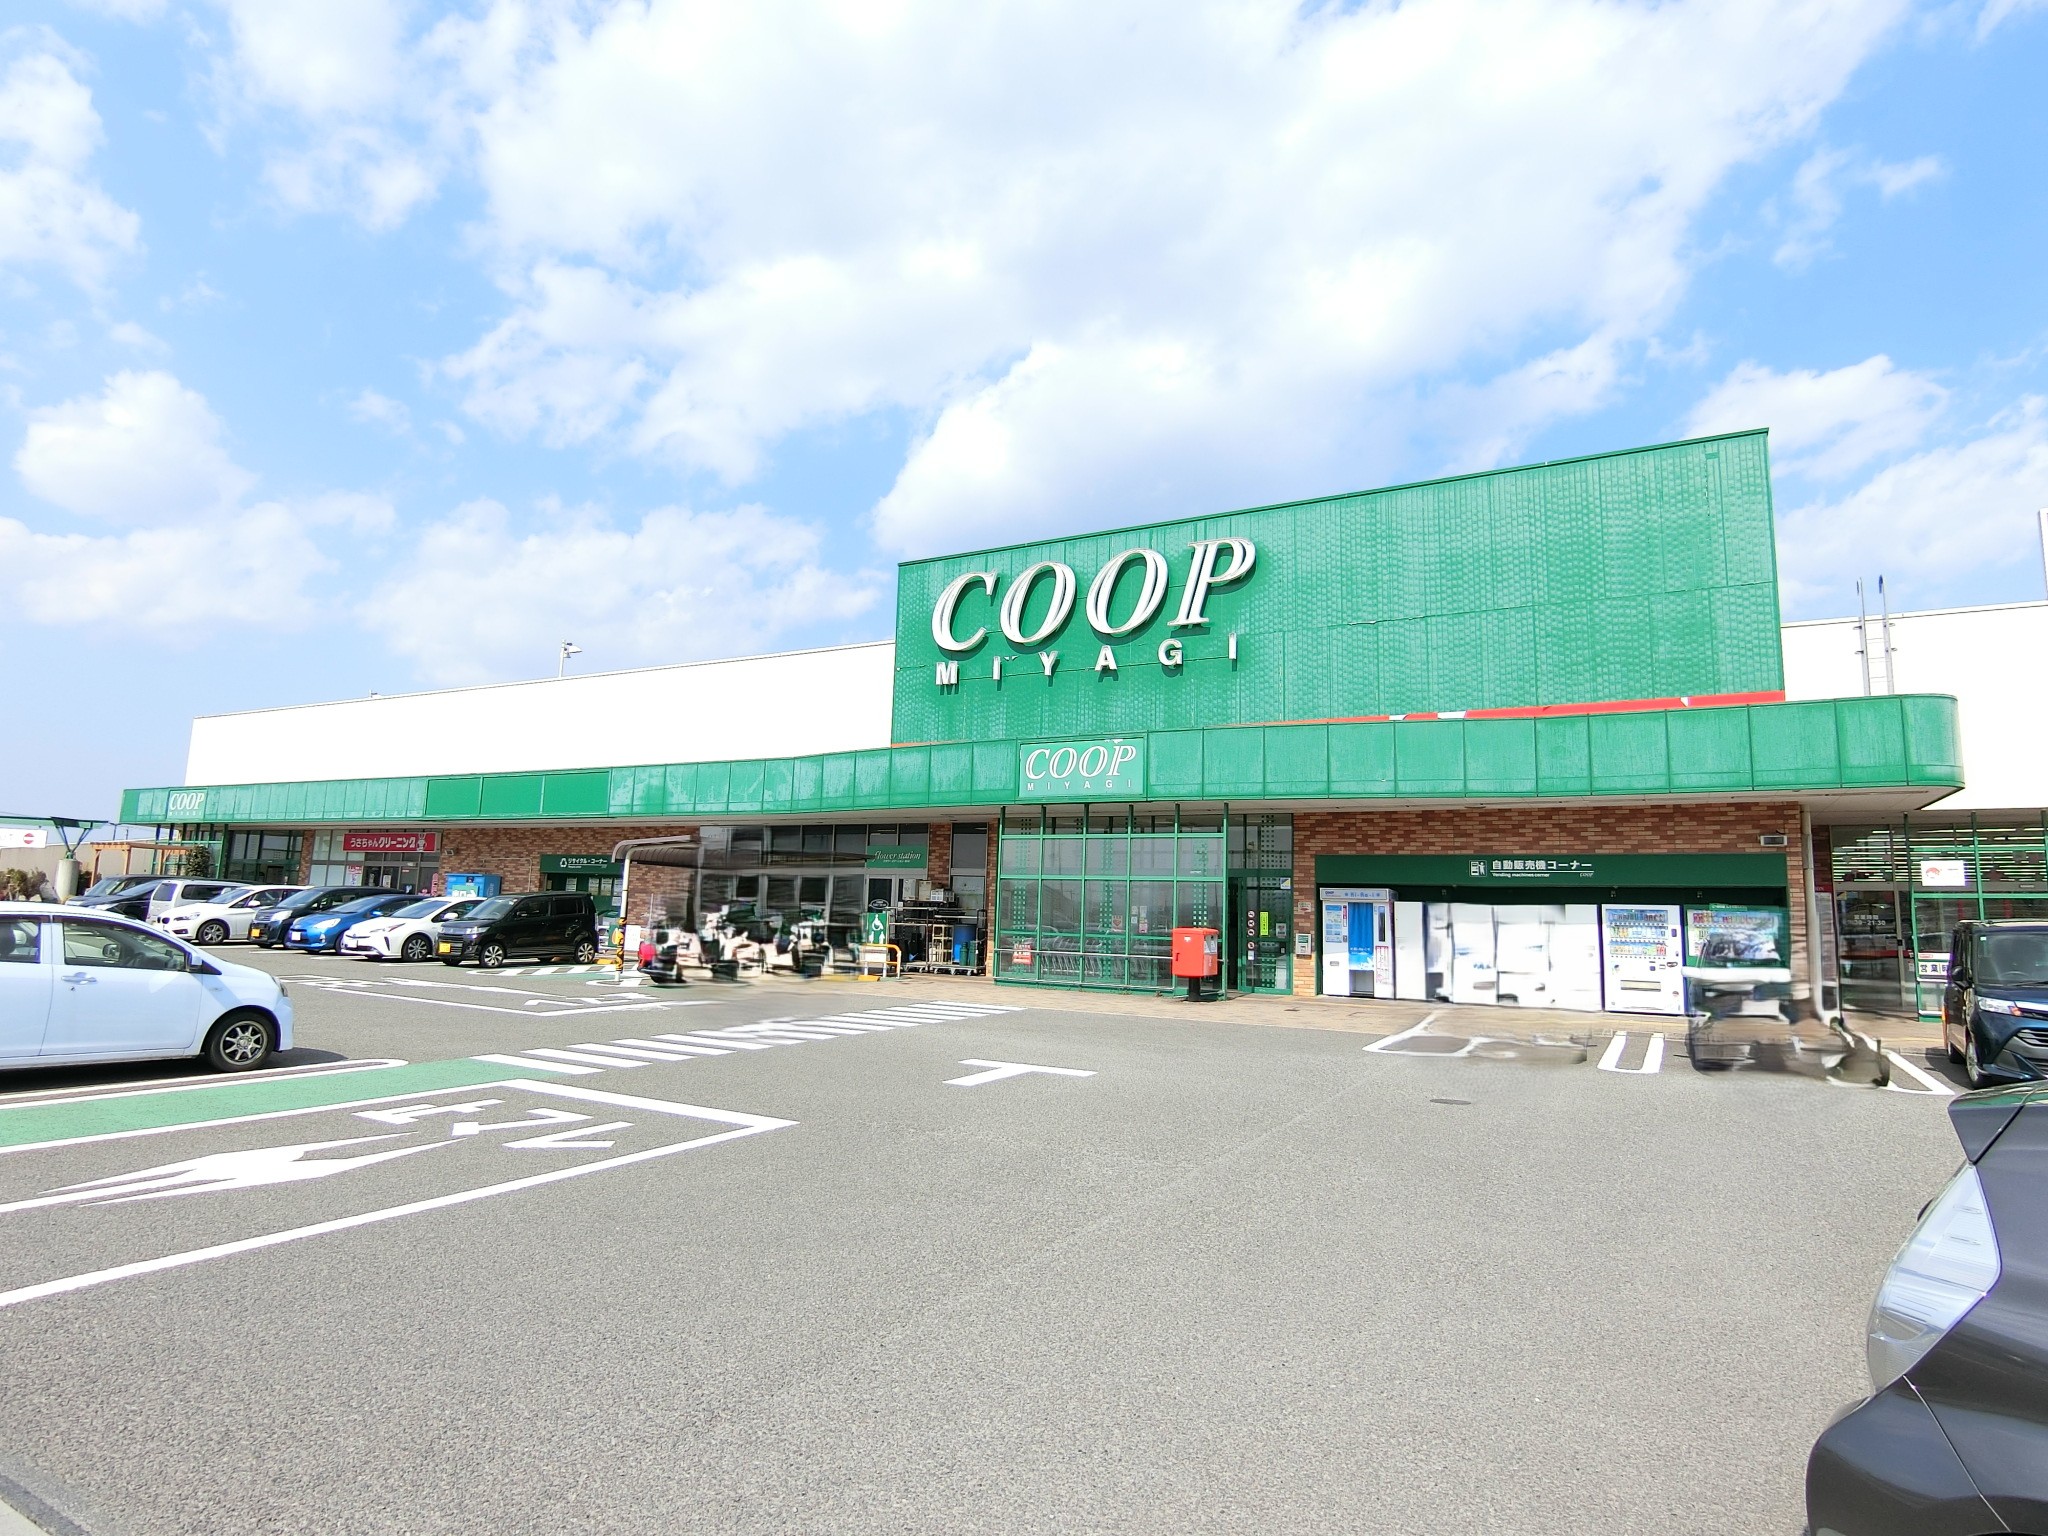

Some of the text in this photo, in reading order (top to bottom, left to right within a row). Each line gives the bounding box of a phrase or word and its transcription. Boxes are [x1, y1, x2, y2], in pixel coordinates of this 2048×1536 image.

[931, 537, 1257, 652] COOP
[935, 632, 1238, 686] MIYAGI
[1025, 744, 1137, 780] COOP
[1027, 779, 1132, 791] MIYAGI
[169, 792, 205, 810] COOP
[350, 836, 416, 849] うさちゃんクリーニング
[872, 850, 921, 862] flower station
[1492, 860, 1593, 870] 自動販売機コーナー
